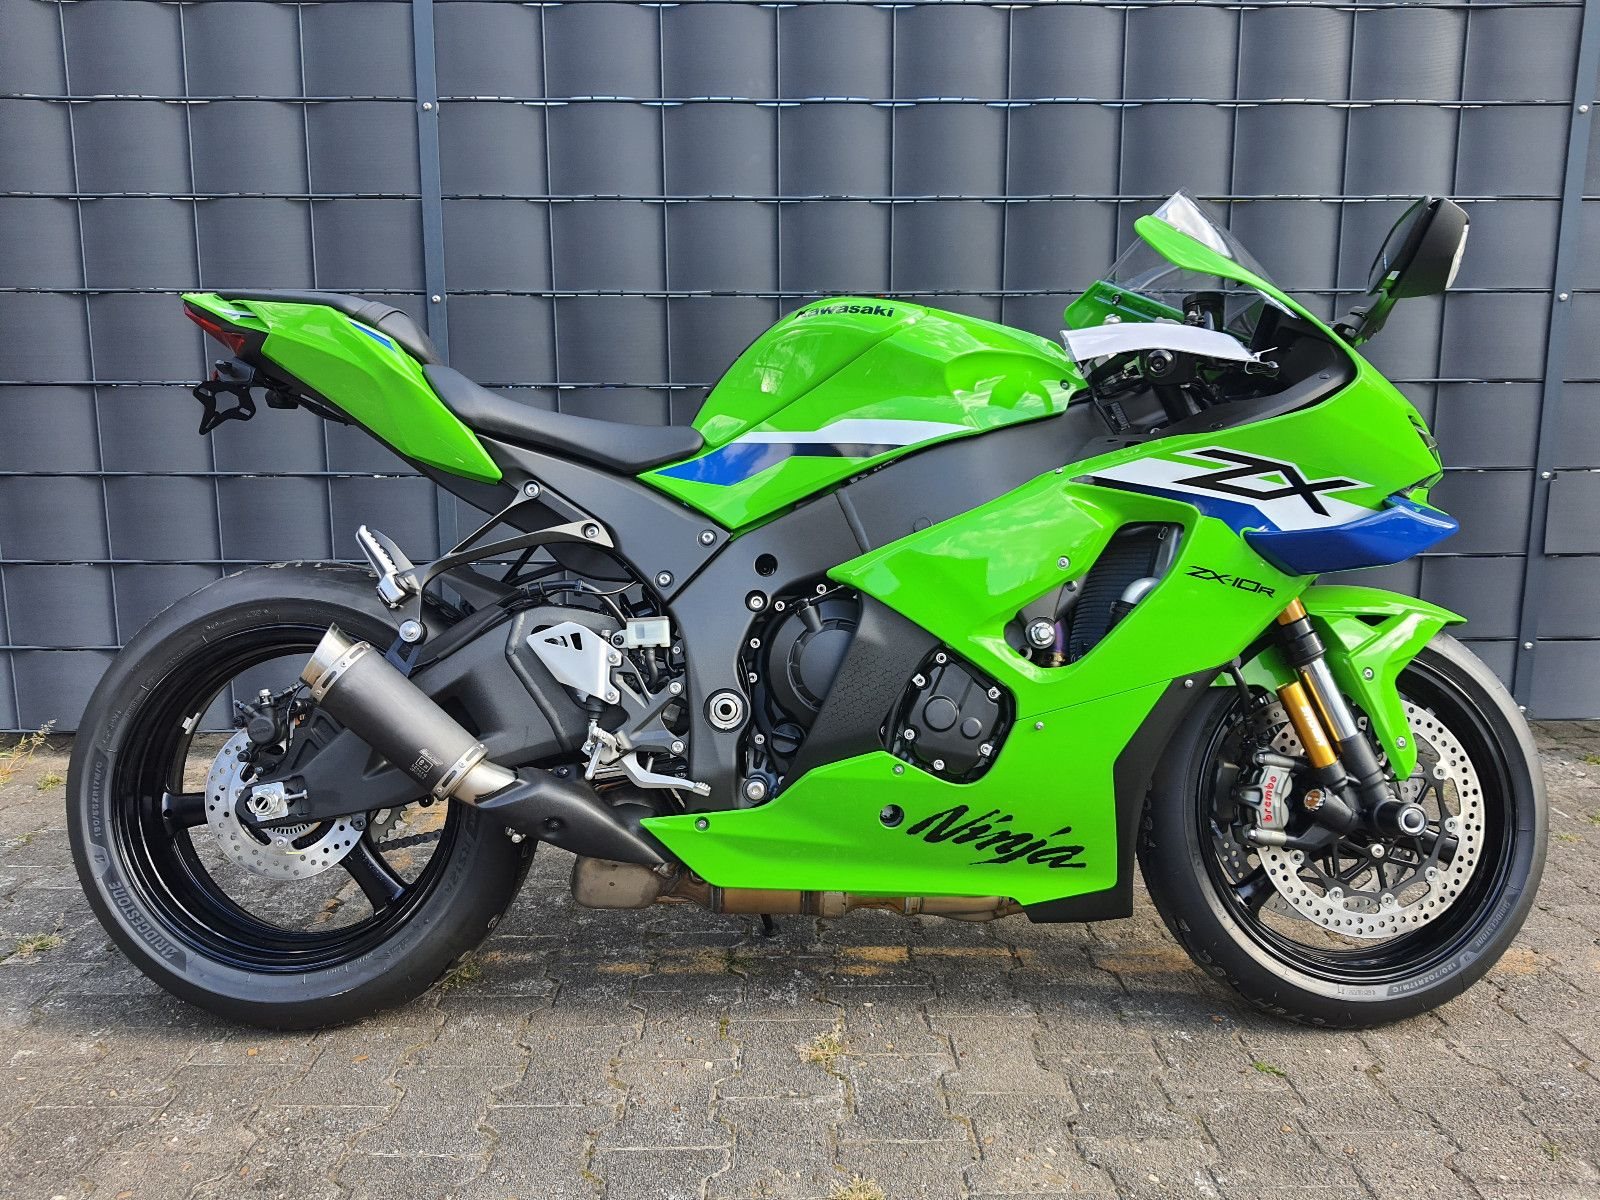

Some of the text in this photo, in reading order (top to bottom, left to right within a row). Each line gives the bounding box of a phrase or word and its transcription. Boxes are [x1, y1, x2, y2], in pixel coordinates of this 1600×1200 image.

[795, 305, 895, 319] Kawasaki
[1172, 448, 1360, 518] ZX
[1184, 565, 1276, 599] ZX-10R
[1263, 775, 1278, 823] brembo
[905, 804, 1087, 869] Ninja
[107, 880, 176, 961] BRIDGESTONE
